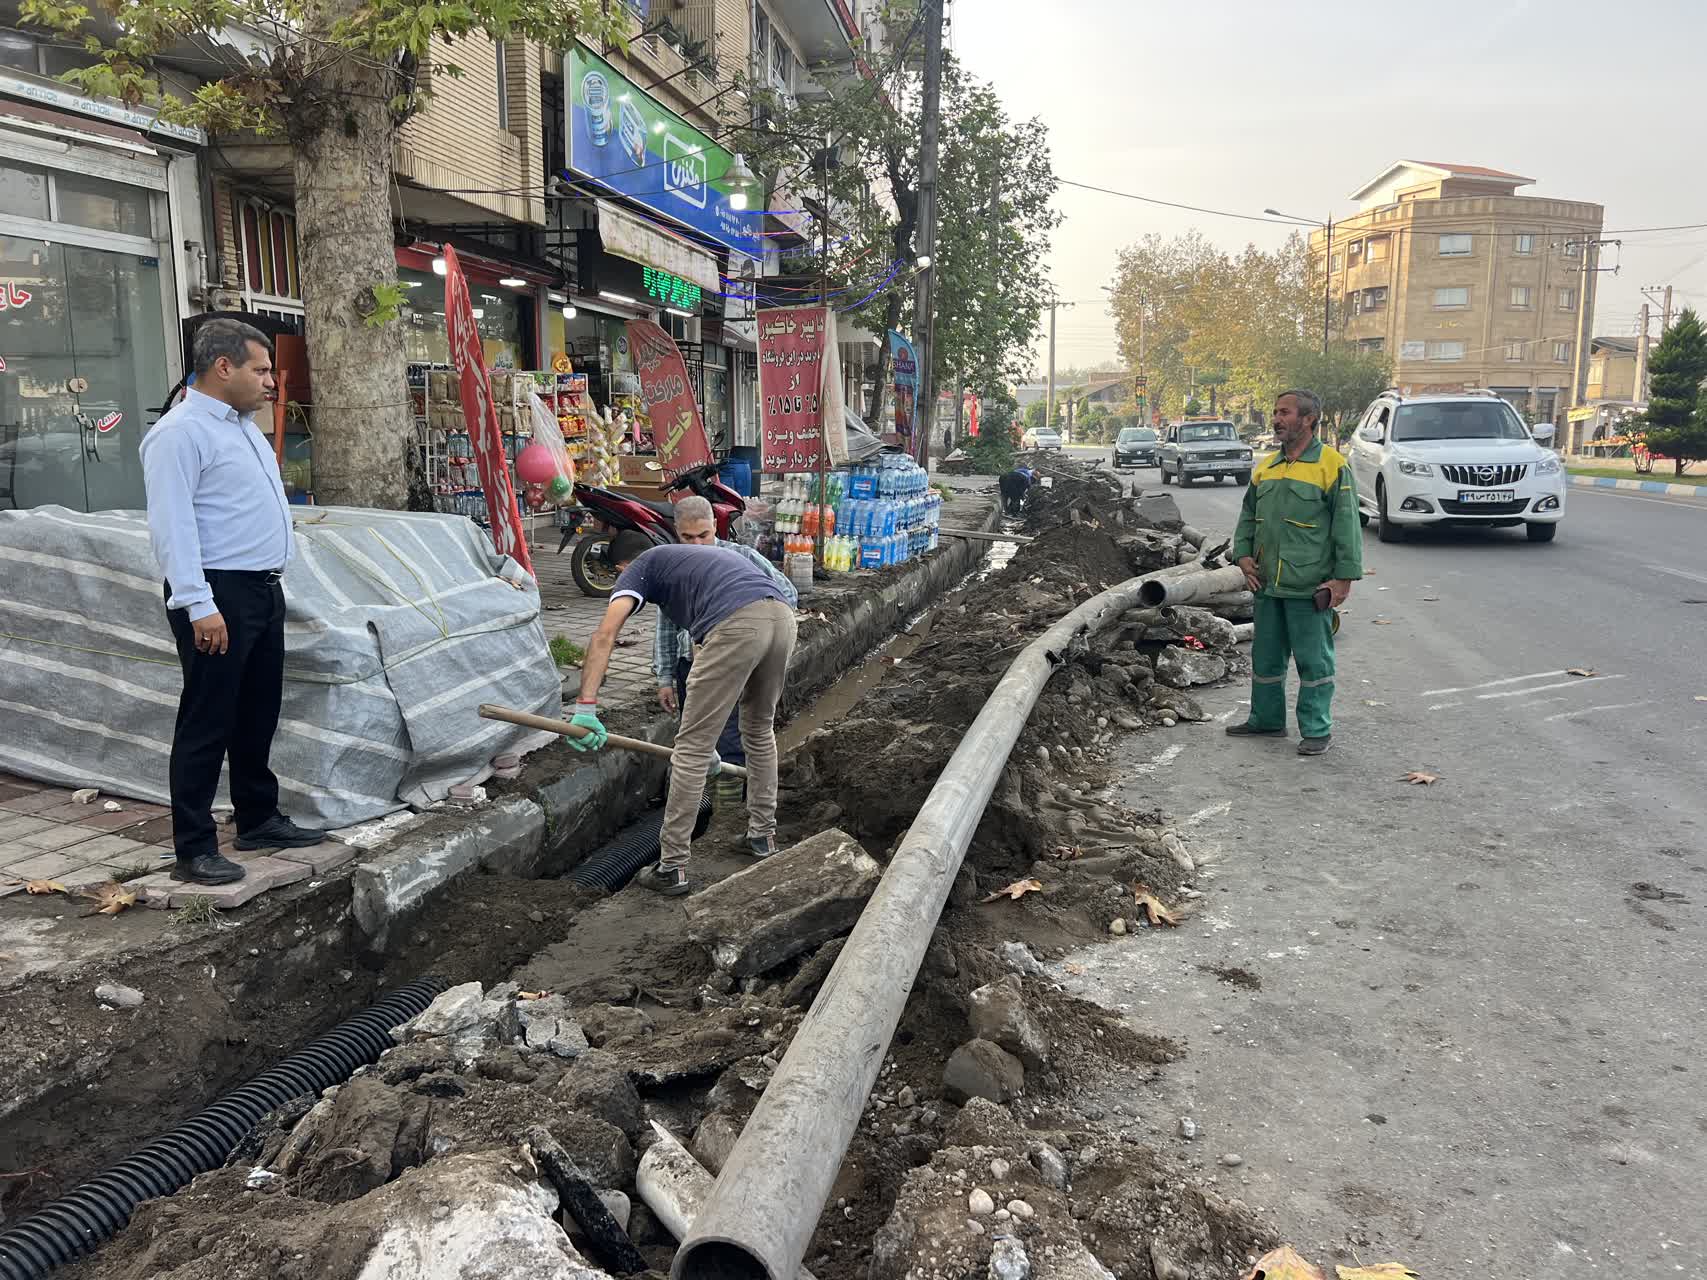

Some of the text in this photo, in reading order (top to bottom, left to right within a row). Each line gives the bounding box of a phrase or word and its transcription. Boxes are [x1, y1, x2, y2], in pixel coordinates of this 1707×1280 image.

[760, 313, 797, 344] خاکپور
[643, 374, 684, 407] مارکت
[788, 372, 801, 391] از
[767, 425, 794, 446] ویژه
[765, 450, 787, 469] شوید
